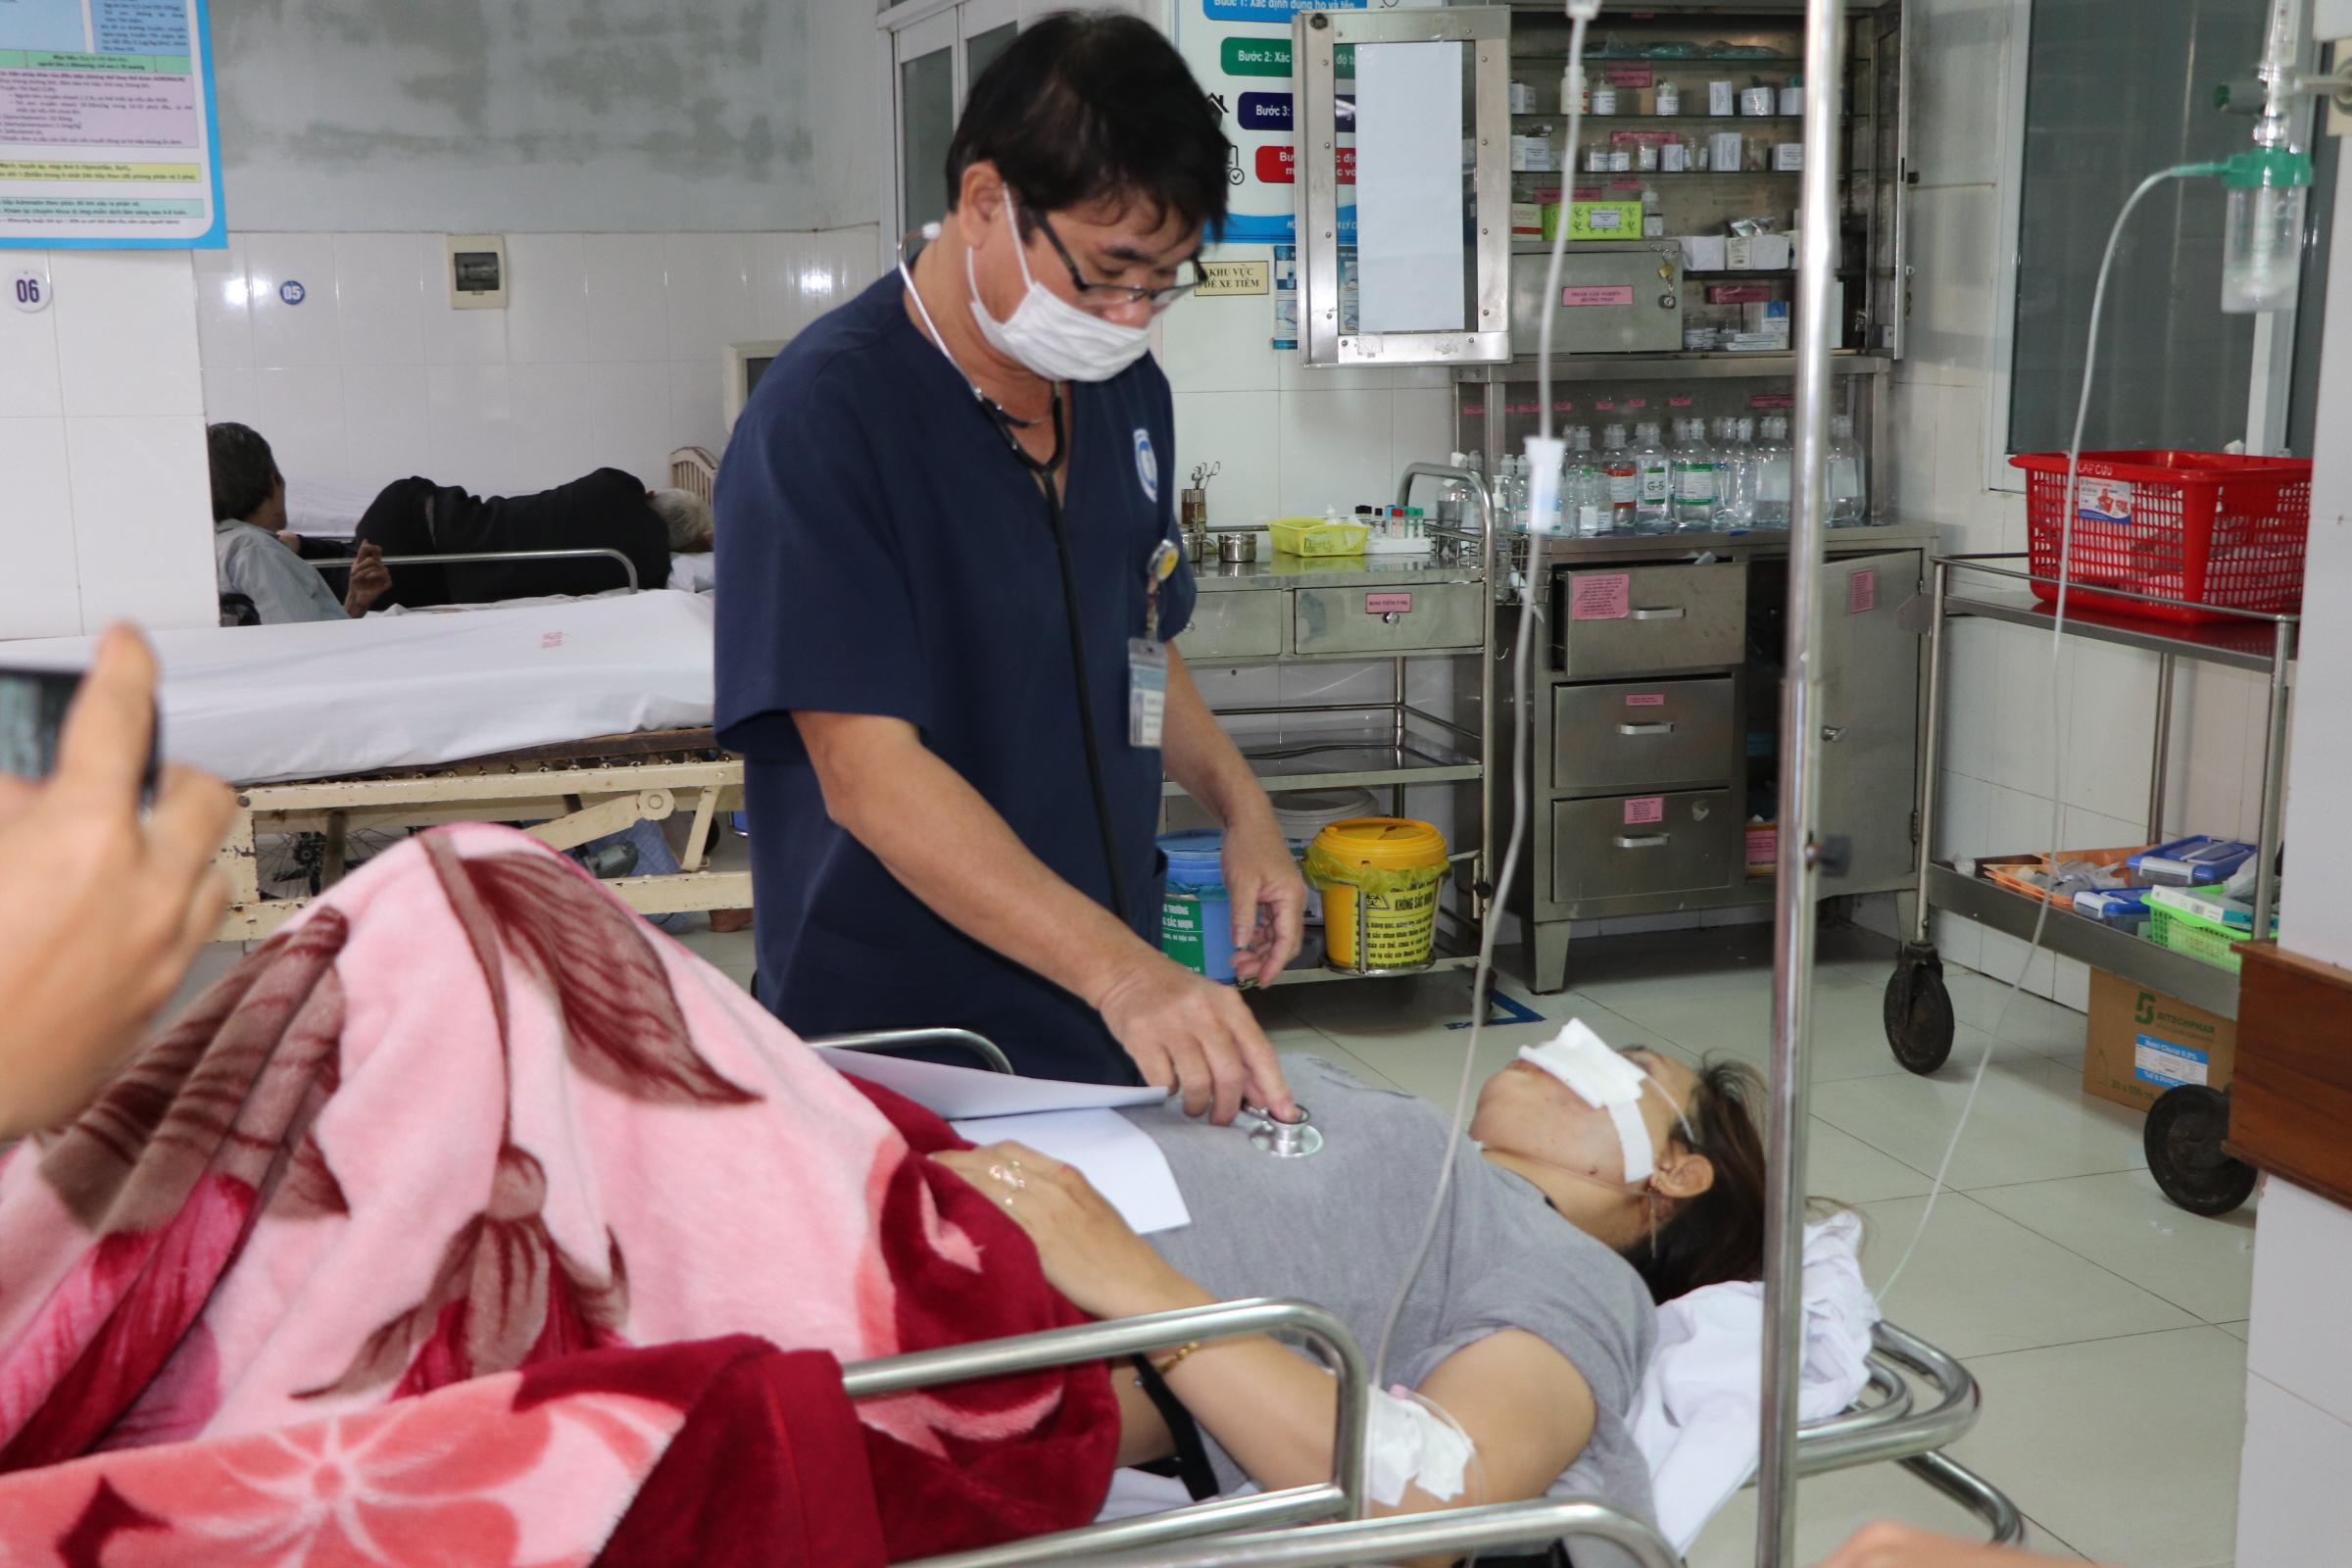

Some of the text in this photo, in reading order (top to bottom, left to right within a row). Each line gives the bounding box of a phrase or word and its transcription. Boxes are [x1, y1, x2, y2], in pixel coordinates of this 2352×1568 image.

[1238, 49, 1263, 63] Bước
[1263, 51, 1273, 63] 2:
[1274, 51, 1291, 64] Xác
[1336, 53, 1348, 68] độ
[1255, 104, 1291, 117] Bước 3:
[1209, 266, 1254, 278] KHU VỰC
[1219, 279, 1233, 289] XE
[1234, 276, 1259, 288] TIÊM
[17, 278, 40, 304] 06
[283, 285, 302, 300] 05
[1646, 480, 1665, 492] G-5
[2161, 1044, 2181, 1056] Clorid
